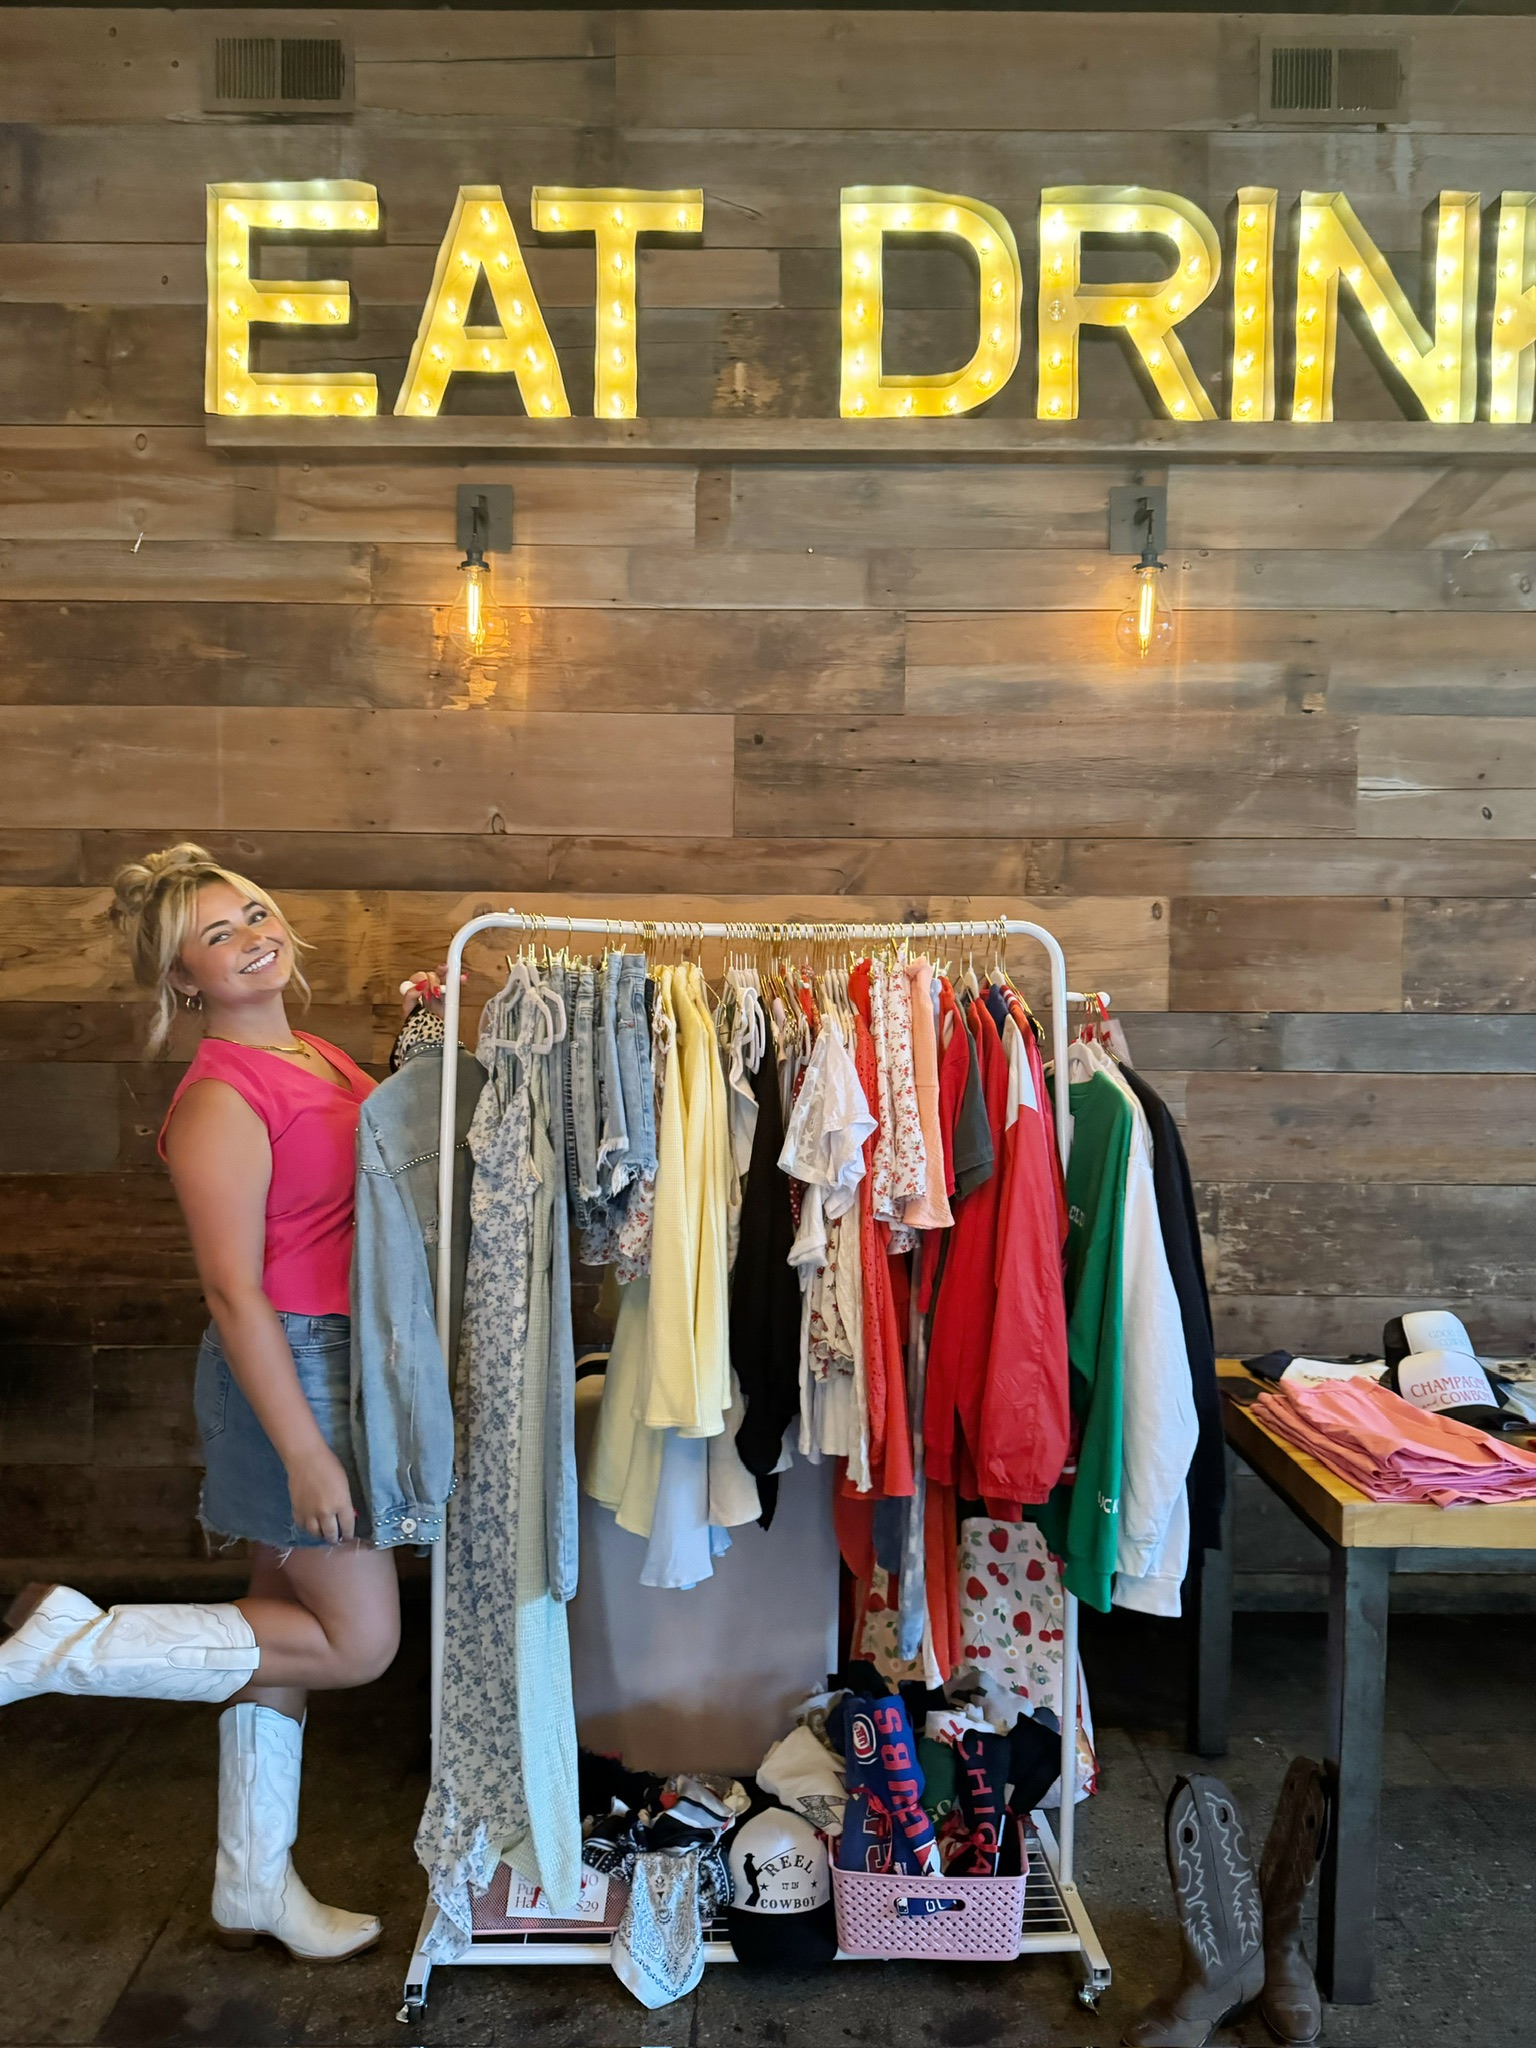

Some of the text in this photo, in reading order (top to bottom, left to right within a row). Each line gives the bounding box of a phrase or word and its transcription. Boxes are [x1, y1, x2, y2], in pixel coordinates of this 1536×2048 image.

[205, 180, 703, 418] EAT
[764, 1854, 814, 1877] REEL
[760, 1896, 817, 1909] COWBOY
